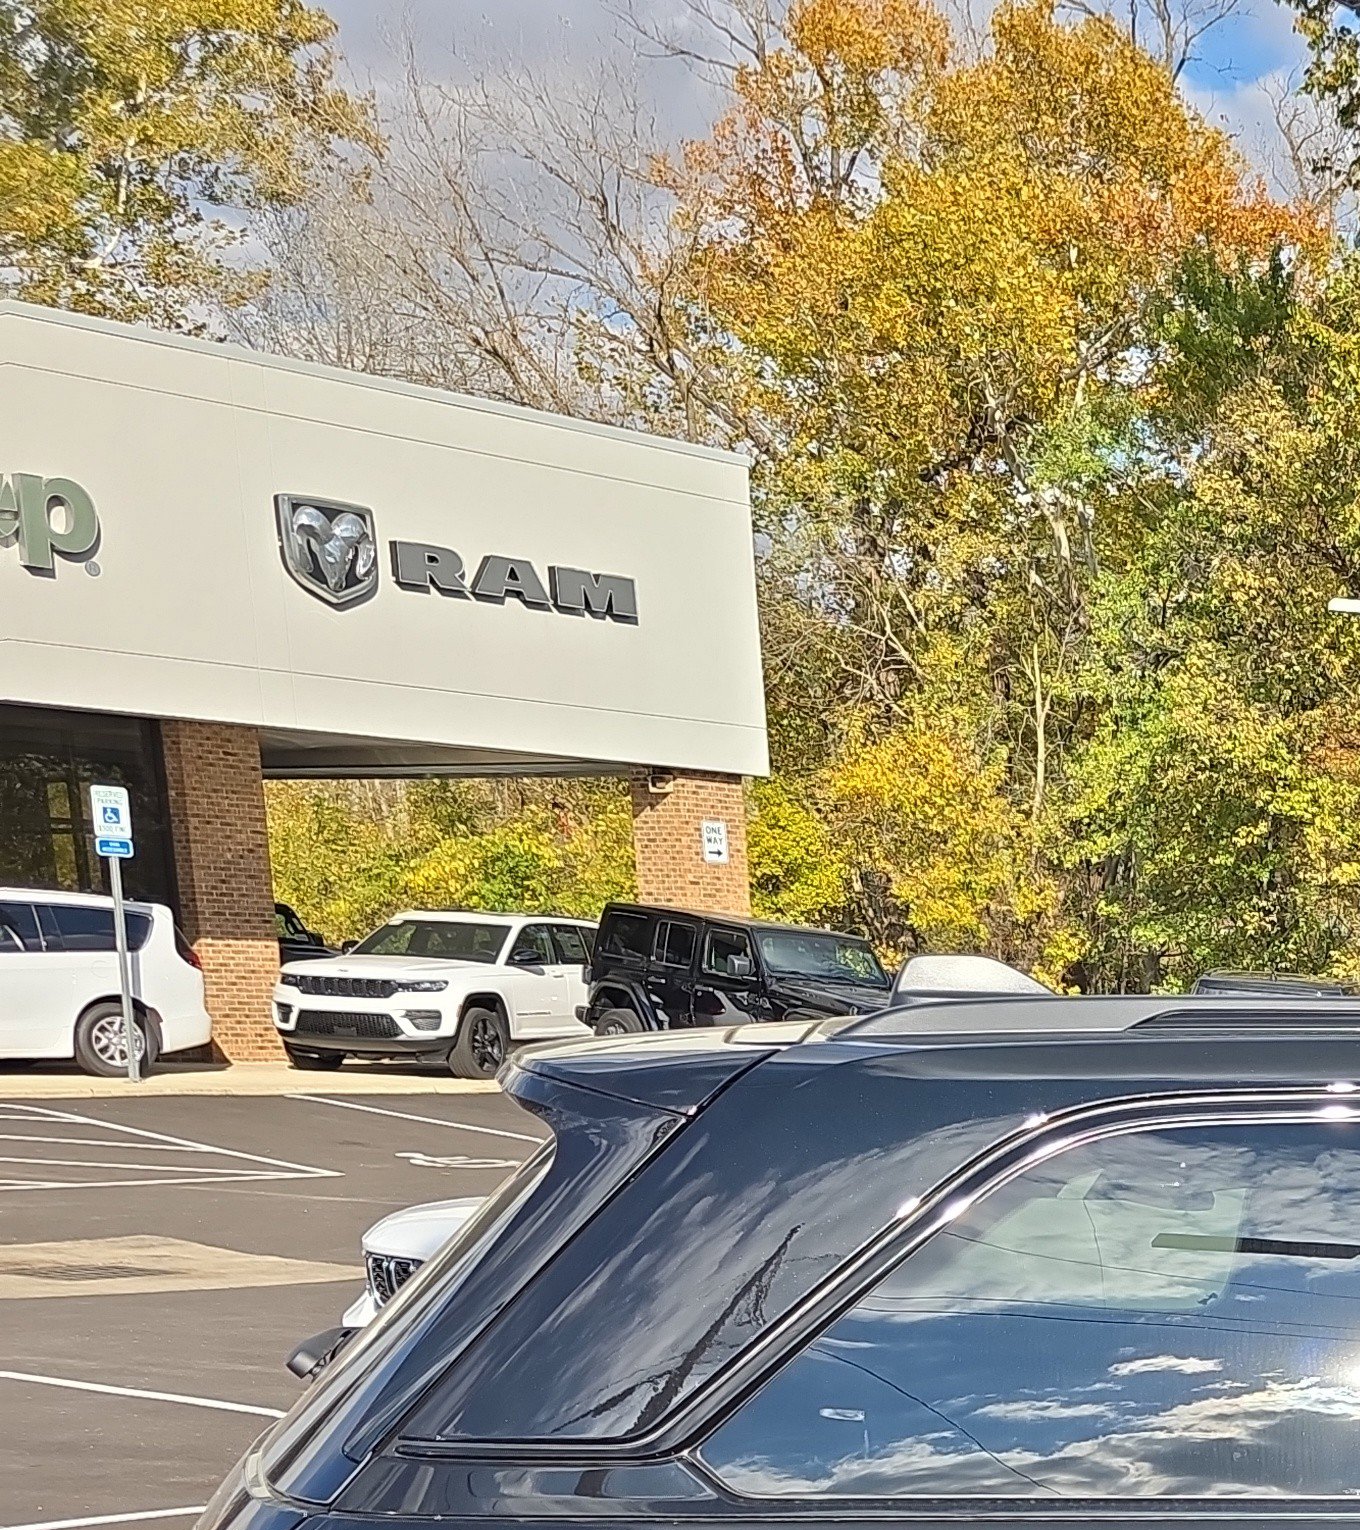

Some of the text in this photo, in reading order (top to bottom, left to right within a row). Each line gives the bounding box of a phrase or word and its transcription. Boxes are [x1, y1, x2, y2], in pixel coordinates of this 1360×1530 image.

[390, 541, 638, 624] RAM
[705, 825, 722, 835] ONE
[706, 836, 723, 845] WAY
